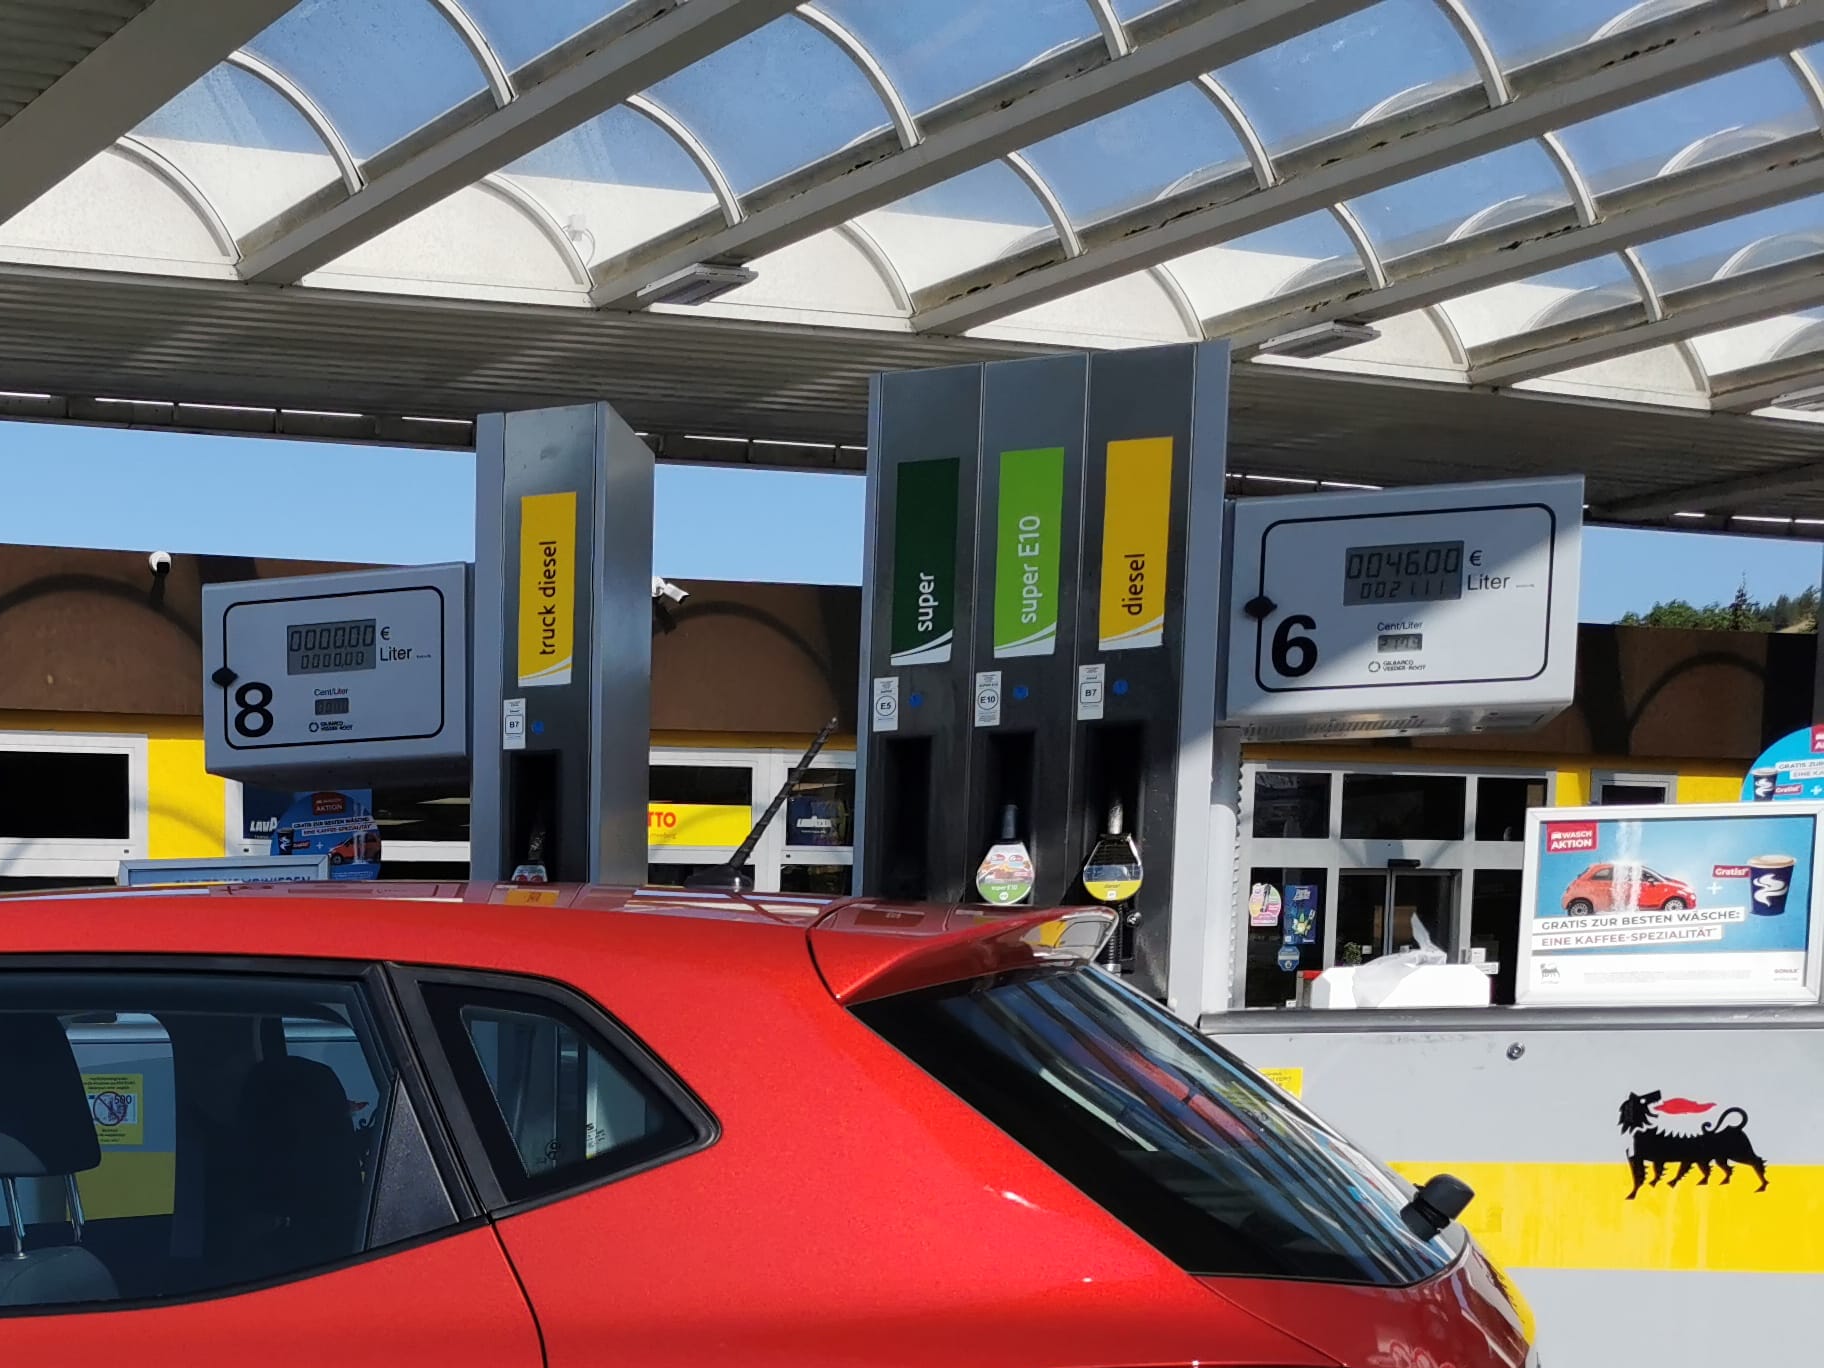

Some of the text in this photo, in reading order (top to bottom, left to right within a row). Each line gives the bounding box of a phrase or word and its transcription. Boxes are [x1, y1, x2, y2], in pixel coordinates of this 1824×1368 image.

[1468, 549, 1483, 567] €
[1018, 515, 1040, 624] super E10
[1122, 552, 1145, 616] diesel
[1467, 574, 1510, 591] Liter
[538, 540, 557, 655] truck diesel
[917, 572, 935, 632] super
[379, 626, 391, 641] €
[1376, 621, 1423, 632] Cent/Liter
[379, 647, 413, 661] Liter
[1271, 614, 1318, 678] 6
[980, 695, 996, 704] E10
[1085, 689, 1097, 697] B7
[233, 681, 275, 738] 8
[880, 702, 892, 710] E5
[1561, 830, 1592, 839] WASCH
[1551, 839, 1592, 850] AKTION
[1541, 910, 1740, 930] GRATIS ZUR BESTEN WÄSCHE:
[1541, 937, 1572, 947] EINE
